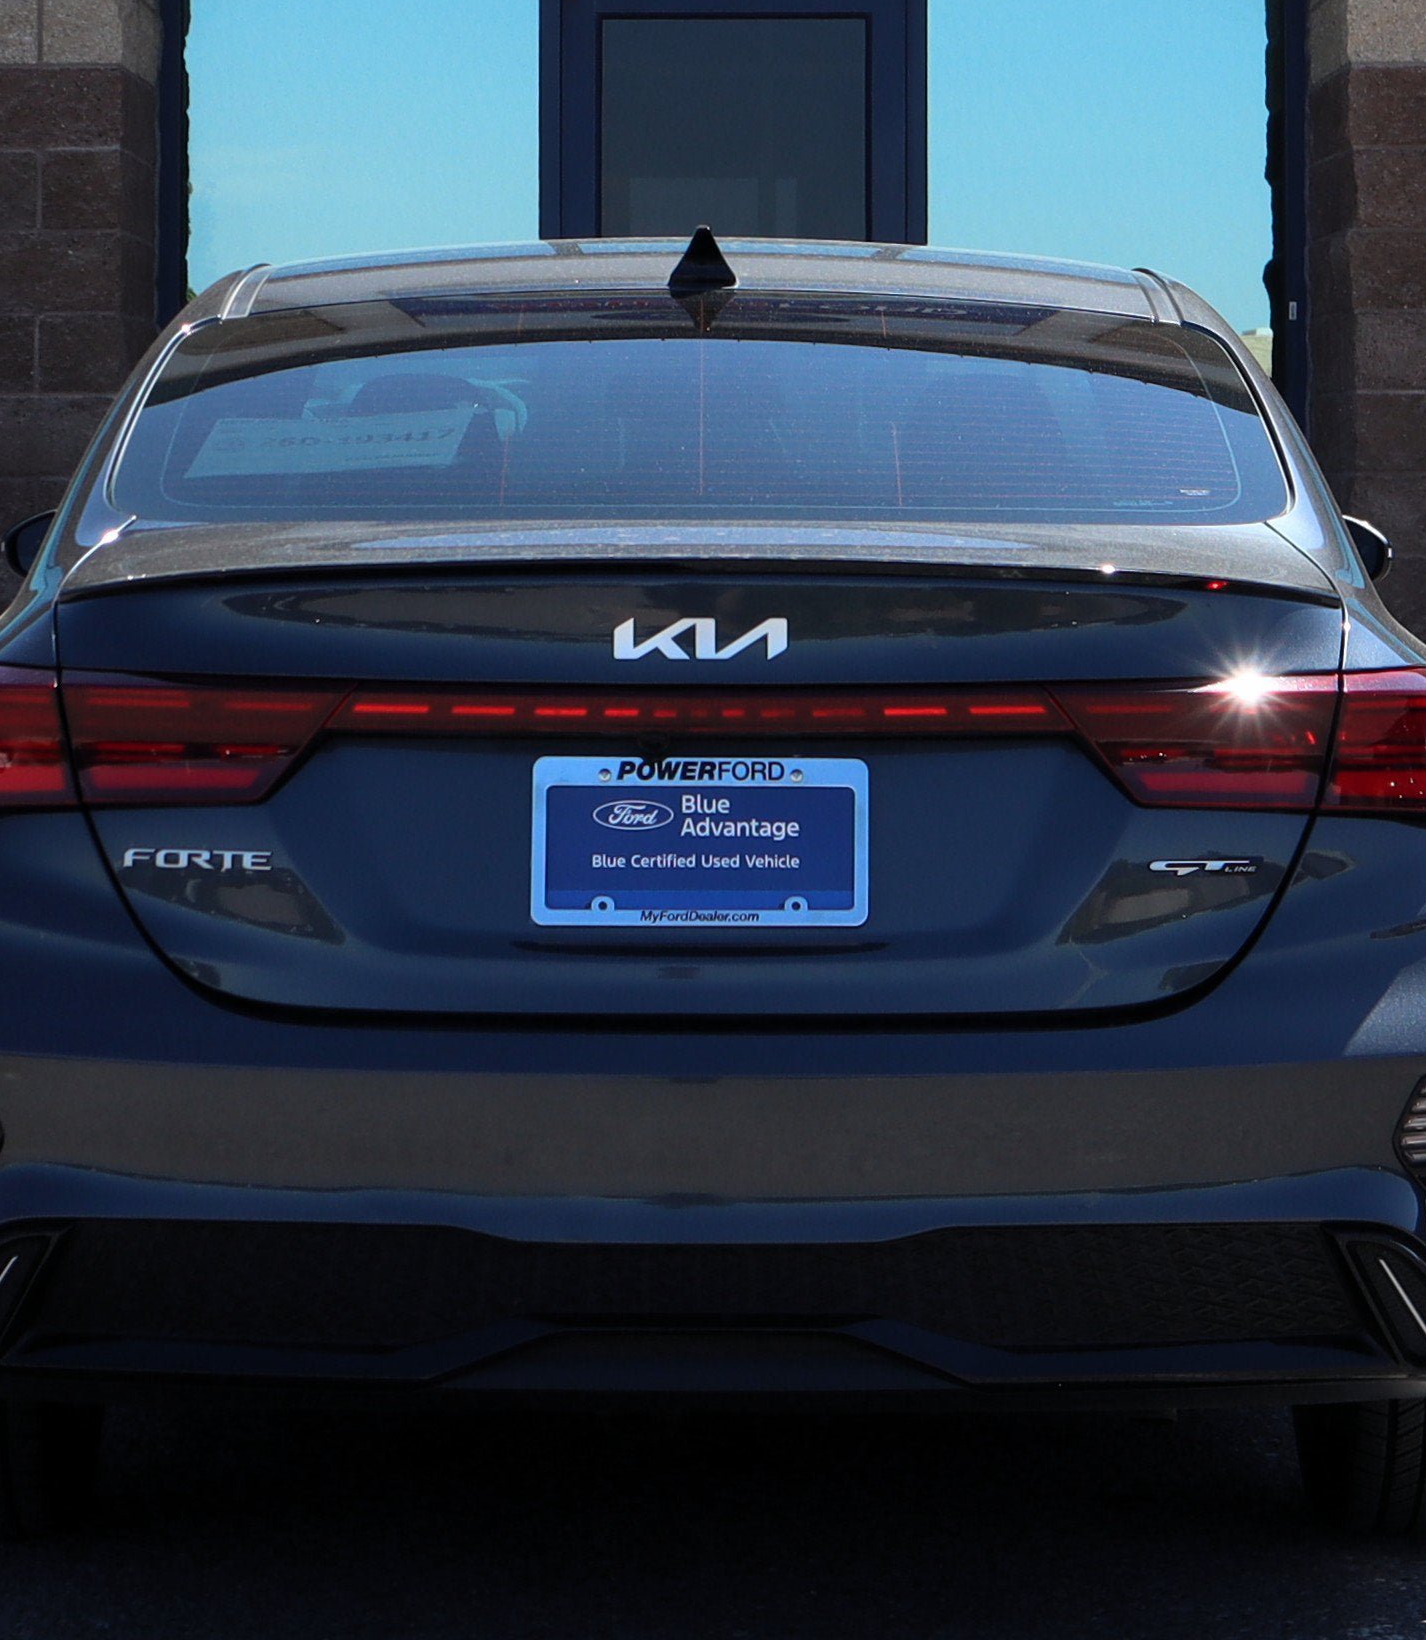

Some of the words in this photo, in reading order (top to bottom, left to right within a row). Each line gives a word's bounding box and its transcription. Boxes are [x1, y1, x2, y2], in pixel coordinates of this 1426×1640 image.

[614, 617, 788, 660] KIA
[617, 760, 785, 781] POWERFORD
[608, 804, 658, 826] Ford
[681, 795, 730, 814] Blue
[680, 818, 800, 841] Advantage
[123, 848, 273, 872] FORTE
[592, 854, 626, 868] Blue
[631, 854, 696, 868] Certified
[701, 855, 740, 868] Used
[745, 854, 800, 868] Vehicle
[1149, 860, 1251, 876] GT
[1224, 865, 1257, 873] LINE
[640, 910, 760, 923] MyFordDealer.com
